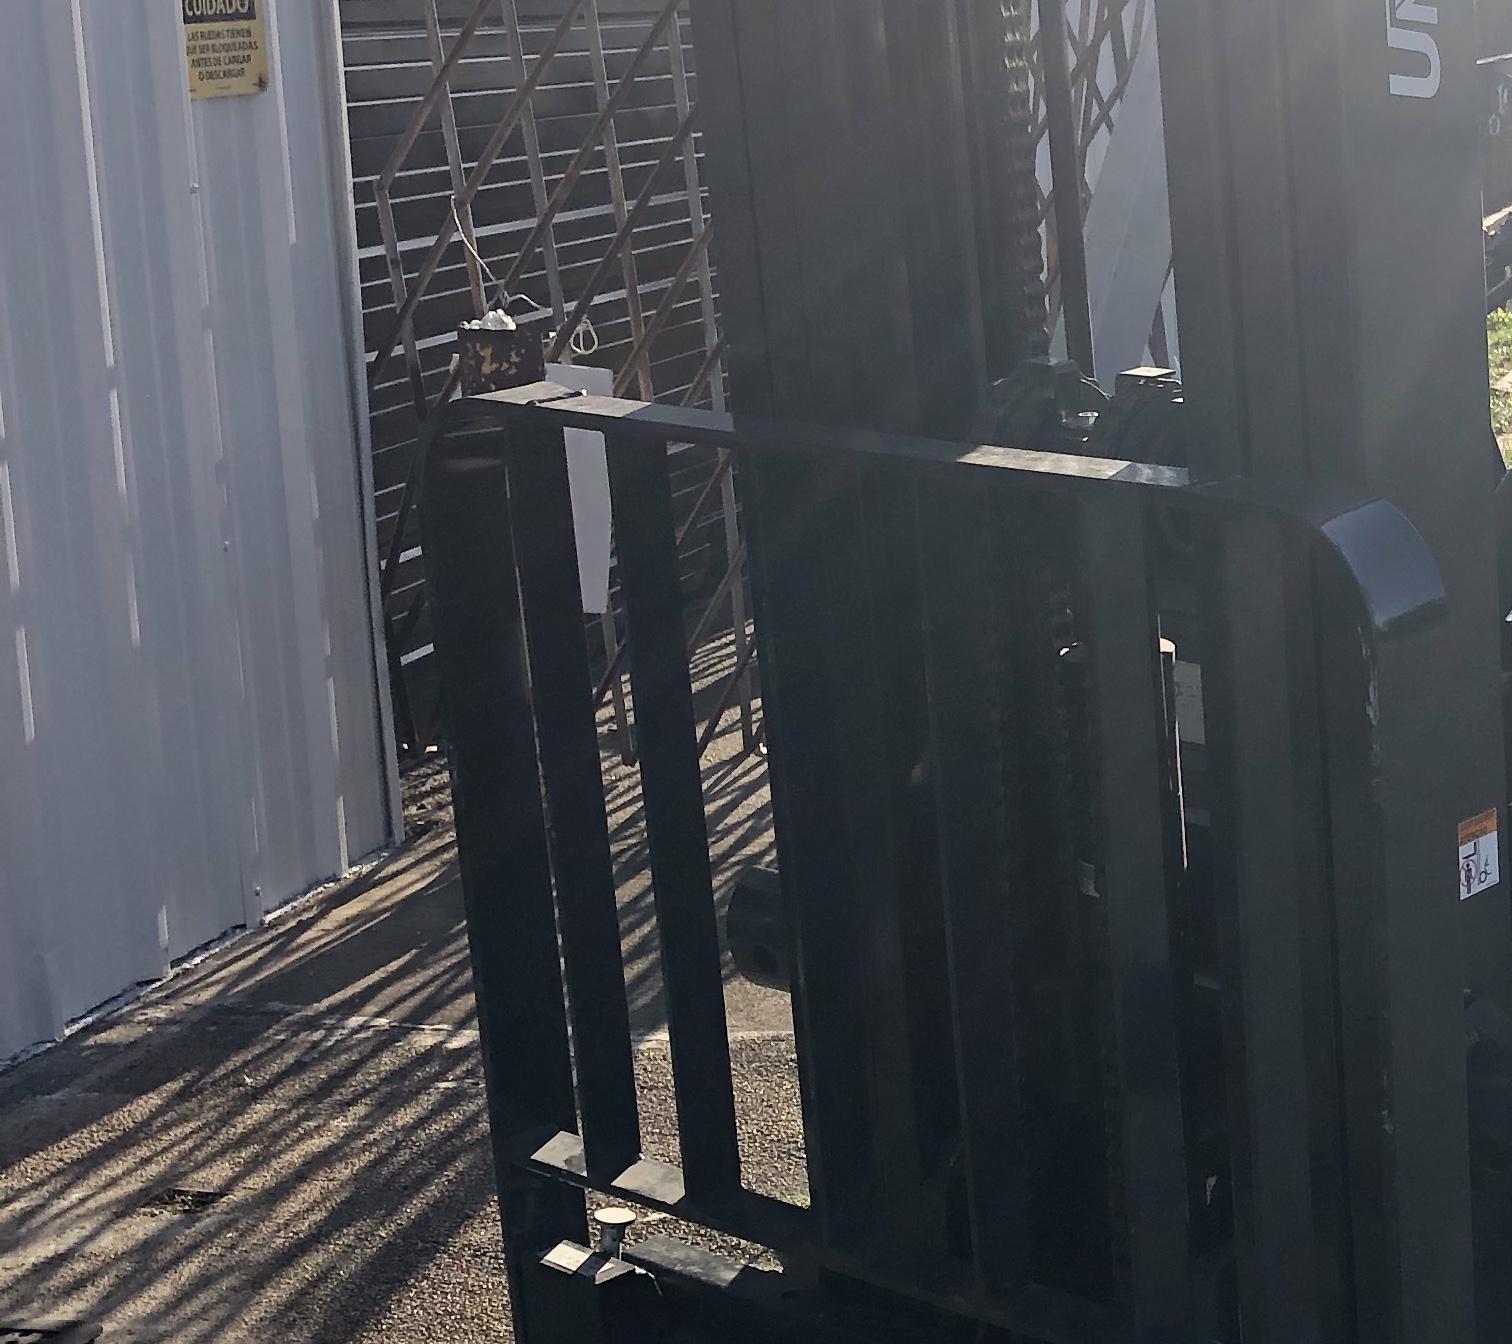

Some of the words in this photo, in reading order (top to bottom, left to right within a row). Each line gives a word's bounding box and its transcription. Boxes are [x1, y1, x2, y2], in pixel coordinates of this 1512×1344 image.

[187, 30, 199, 42] LAS
[200, 29, 225, 41] RUEDAS
[226, 27, 252, 39] TIENEN
[198, 43, 210, 54] SER
[211, 40, 259, 55] BLOQUEADAS
[191, 56, 212, 69] ANTES
[213, 56, 222, 67] DE
[223, 54, 252, 67] CARGAR
